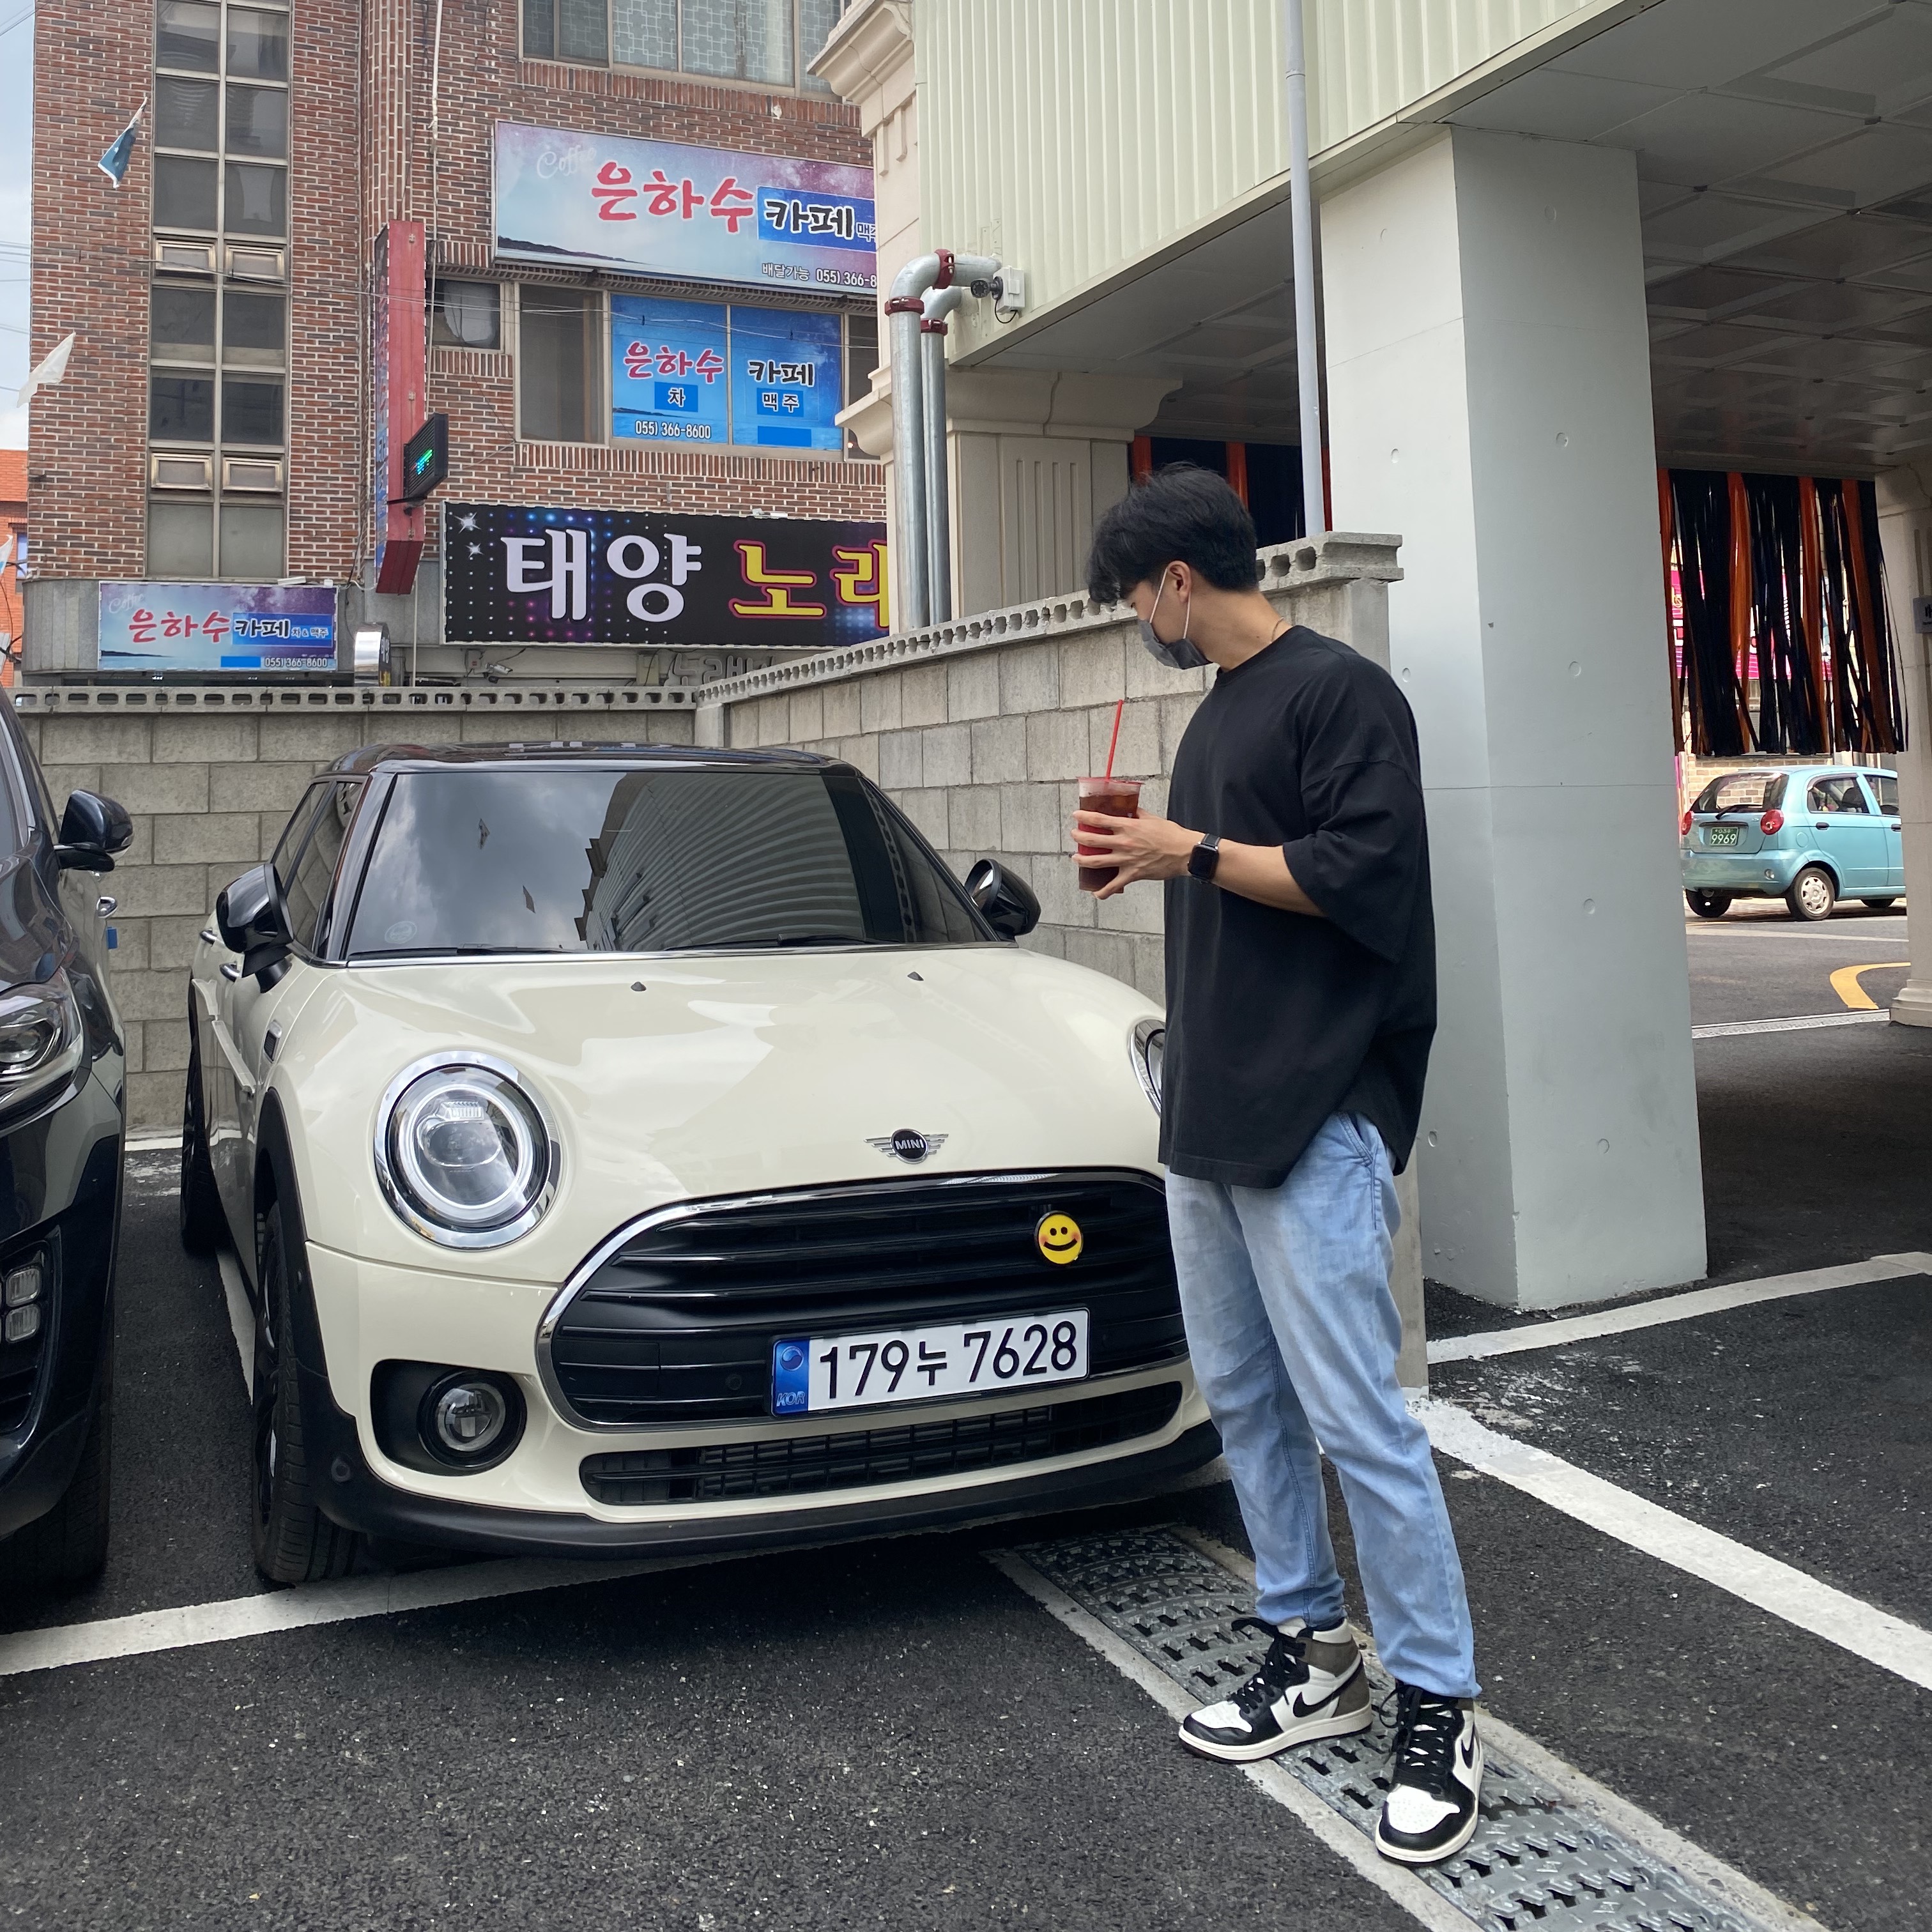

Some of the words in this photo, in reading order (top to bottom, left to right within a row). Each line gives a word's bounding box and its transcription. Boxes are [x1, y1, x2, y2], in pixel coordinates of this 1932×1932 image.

[591, 161, 755, 234] 은하수
[765, 199, 855, 240] 카페
[762, 263, 809, 281] 배달가능
[816, 268, 841, 284] 055)
[624, 342, 724, 383] 은하수
[748, 359, 815, 387] 카페
[668, 387, 686, 407] 차
[635, 420, 658, 436] 055)
[661, 422, 711, 439] 366-8600
[500, 529, 702, 622] 태양
[129, 608, 230, 643] 은하수
[234, 618, 290, 638] 카페
[291, 627, 301, 638] 차
[310, 627, 328, 638] 맥주
[286, 657, 328, 668] 366-8600
[1712, 834, 1736, 844] 9969
[895, 1139, 924, 1149] MINI
[820, 1340, 947, 1399] 179누
[963, 1321, 1077, 1383] 7628
[776, 1390, 806, 1407] KOR
